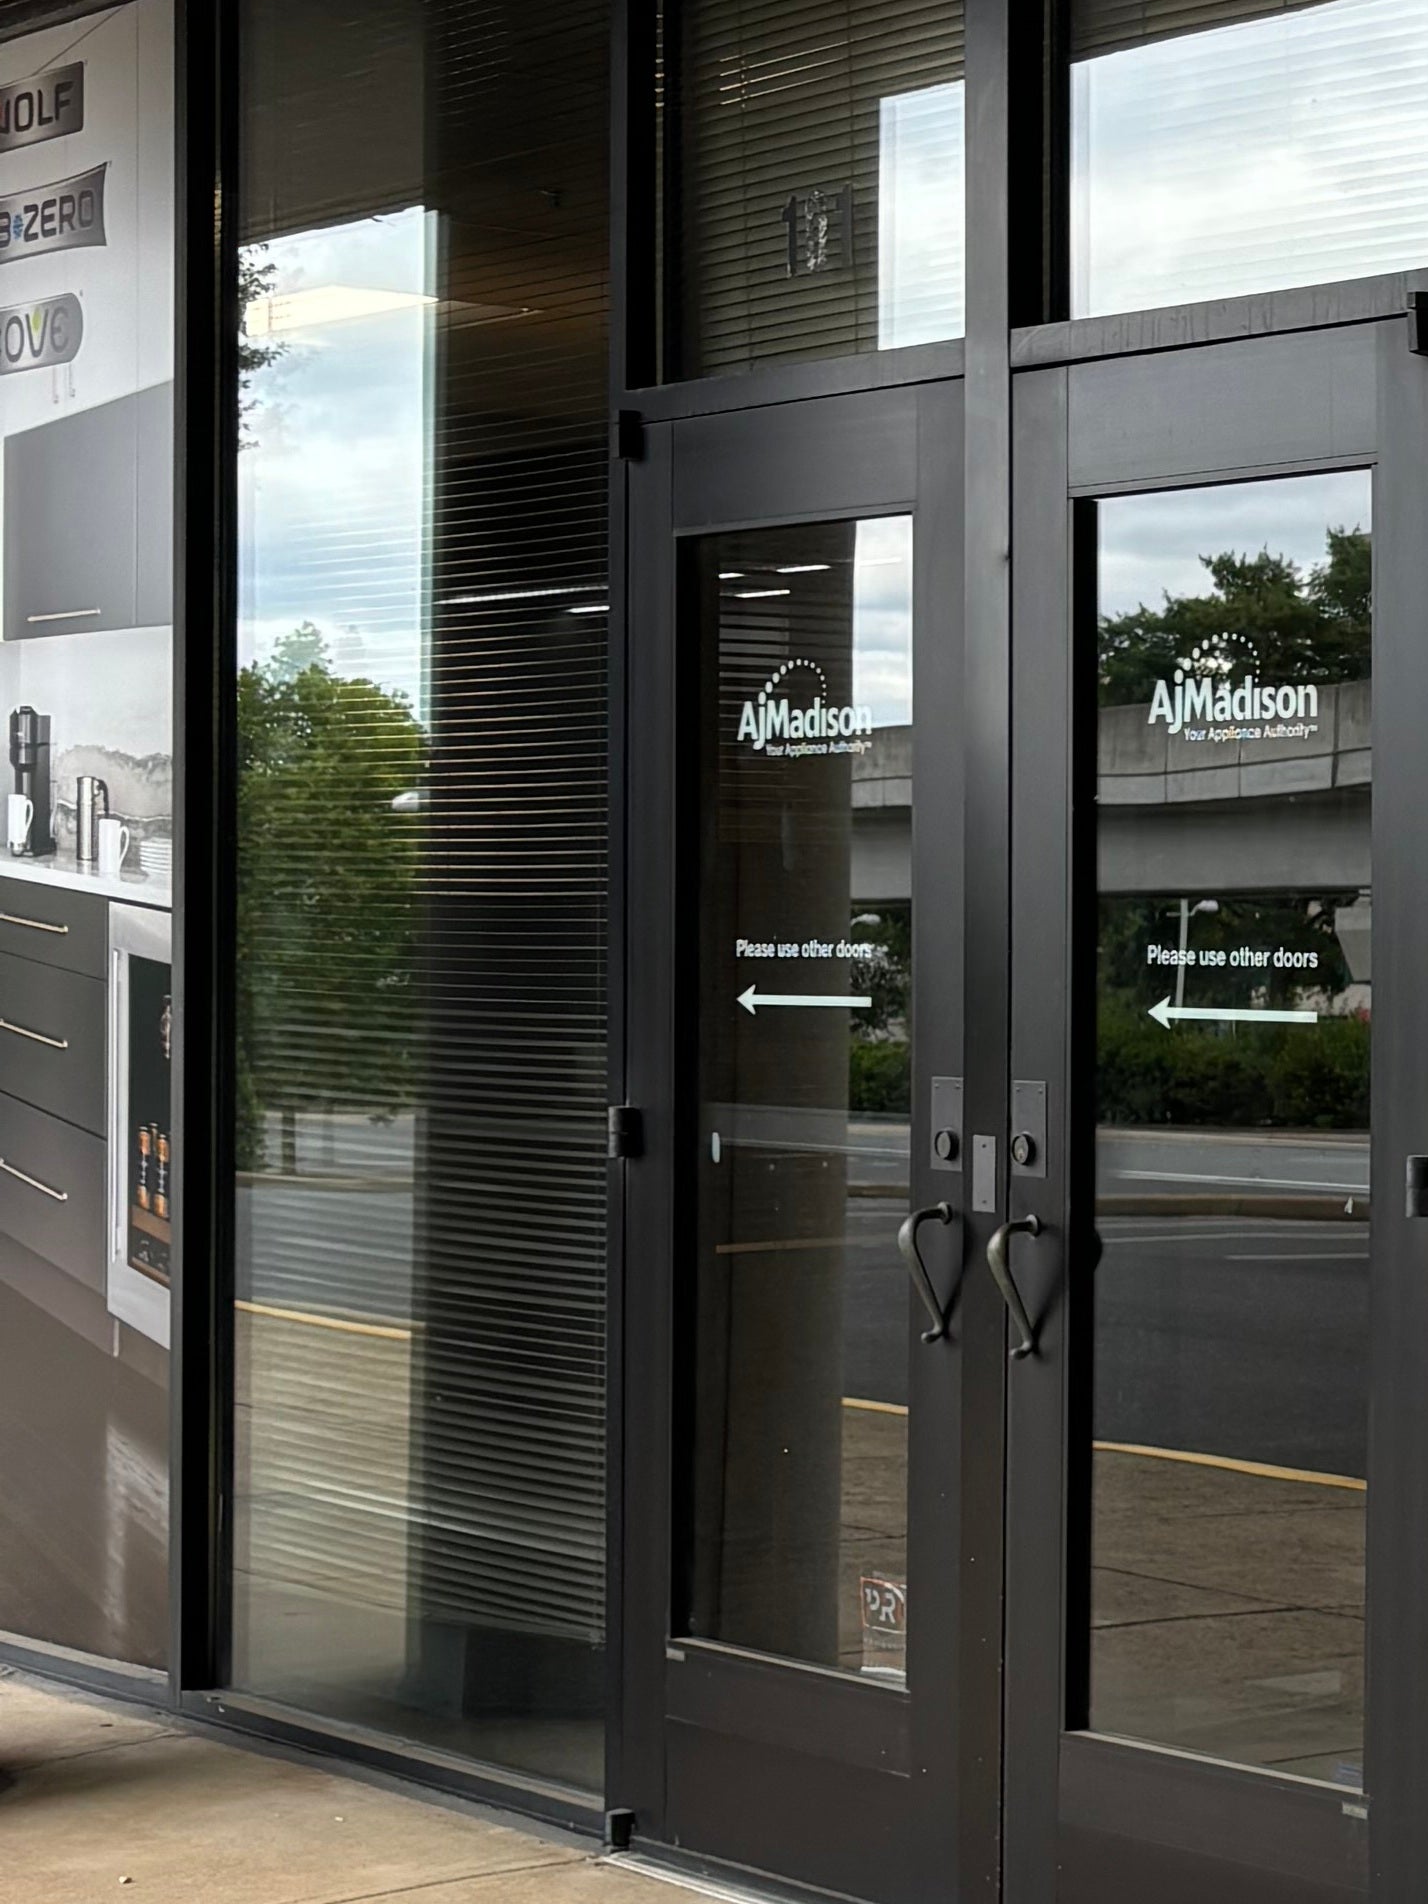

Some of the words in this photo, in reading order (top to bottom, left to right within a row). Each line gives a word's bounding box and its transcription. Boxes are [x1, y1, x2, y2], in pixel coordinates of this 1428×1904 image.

[0, 306, 70, 364] OVE
[737, 692, 872, 750] AjMadison
[1147, 669, 1318, 734] AjMadison
[1184, 726, 1207, 741] Your
[1207, 725, 1262, 743] Appliance
[735, 939, 775, 958] Please
[777, 943, 800, 958] use
[801, 939, 834, 958] other
[836, 939, 873, 958] doors
[1147, 944, 1196, 966] Please
[1199, 949, 1226, 967] use
[1229, 946, 1271, 967] other
[1273, 946, 1318, 968] doors
